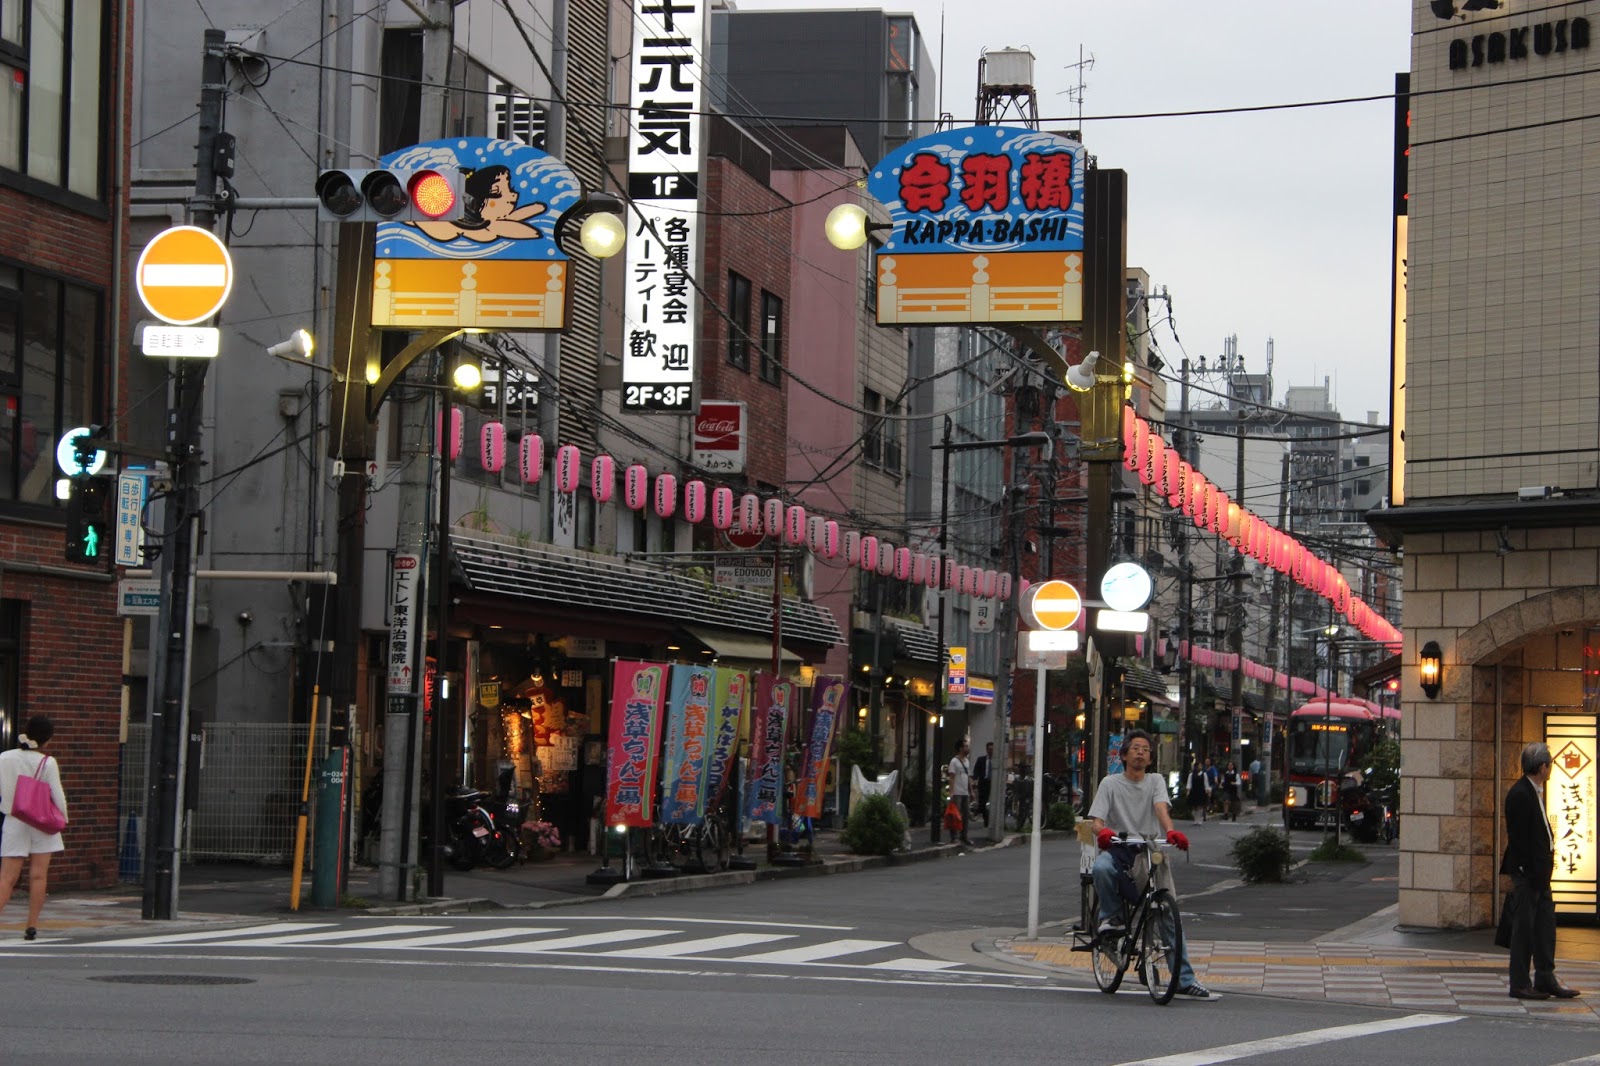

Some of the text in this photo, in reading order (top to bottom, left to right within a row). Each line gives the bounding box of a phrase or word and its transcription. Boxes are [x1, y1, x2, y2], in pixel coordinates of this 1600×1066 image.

[1449, 16, 1591, 71] ASAKUSA
[652, 175, 679, 196] 1F
[900, 152, 1073, 213] 合羽橋
[903, 217, 1069, 246] KAPPA BASHI
[633, 214, 661, 324] パーティー
[662, 216, 690, 325] 各種宴会
[121, 482, 131, 526] 自転車
[129, 484, 140, 528] 歩行者
[123, 530, 133, 559] 専用
[734, 569, 771, 577] EDOYADO
[391, 572, 410, 664] エトレ東洋治療院
[1561, 783, 1584, 874] 浅草今半
